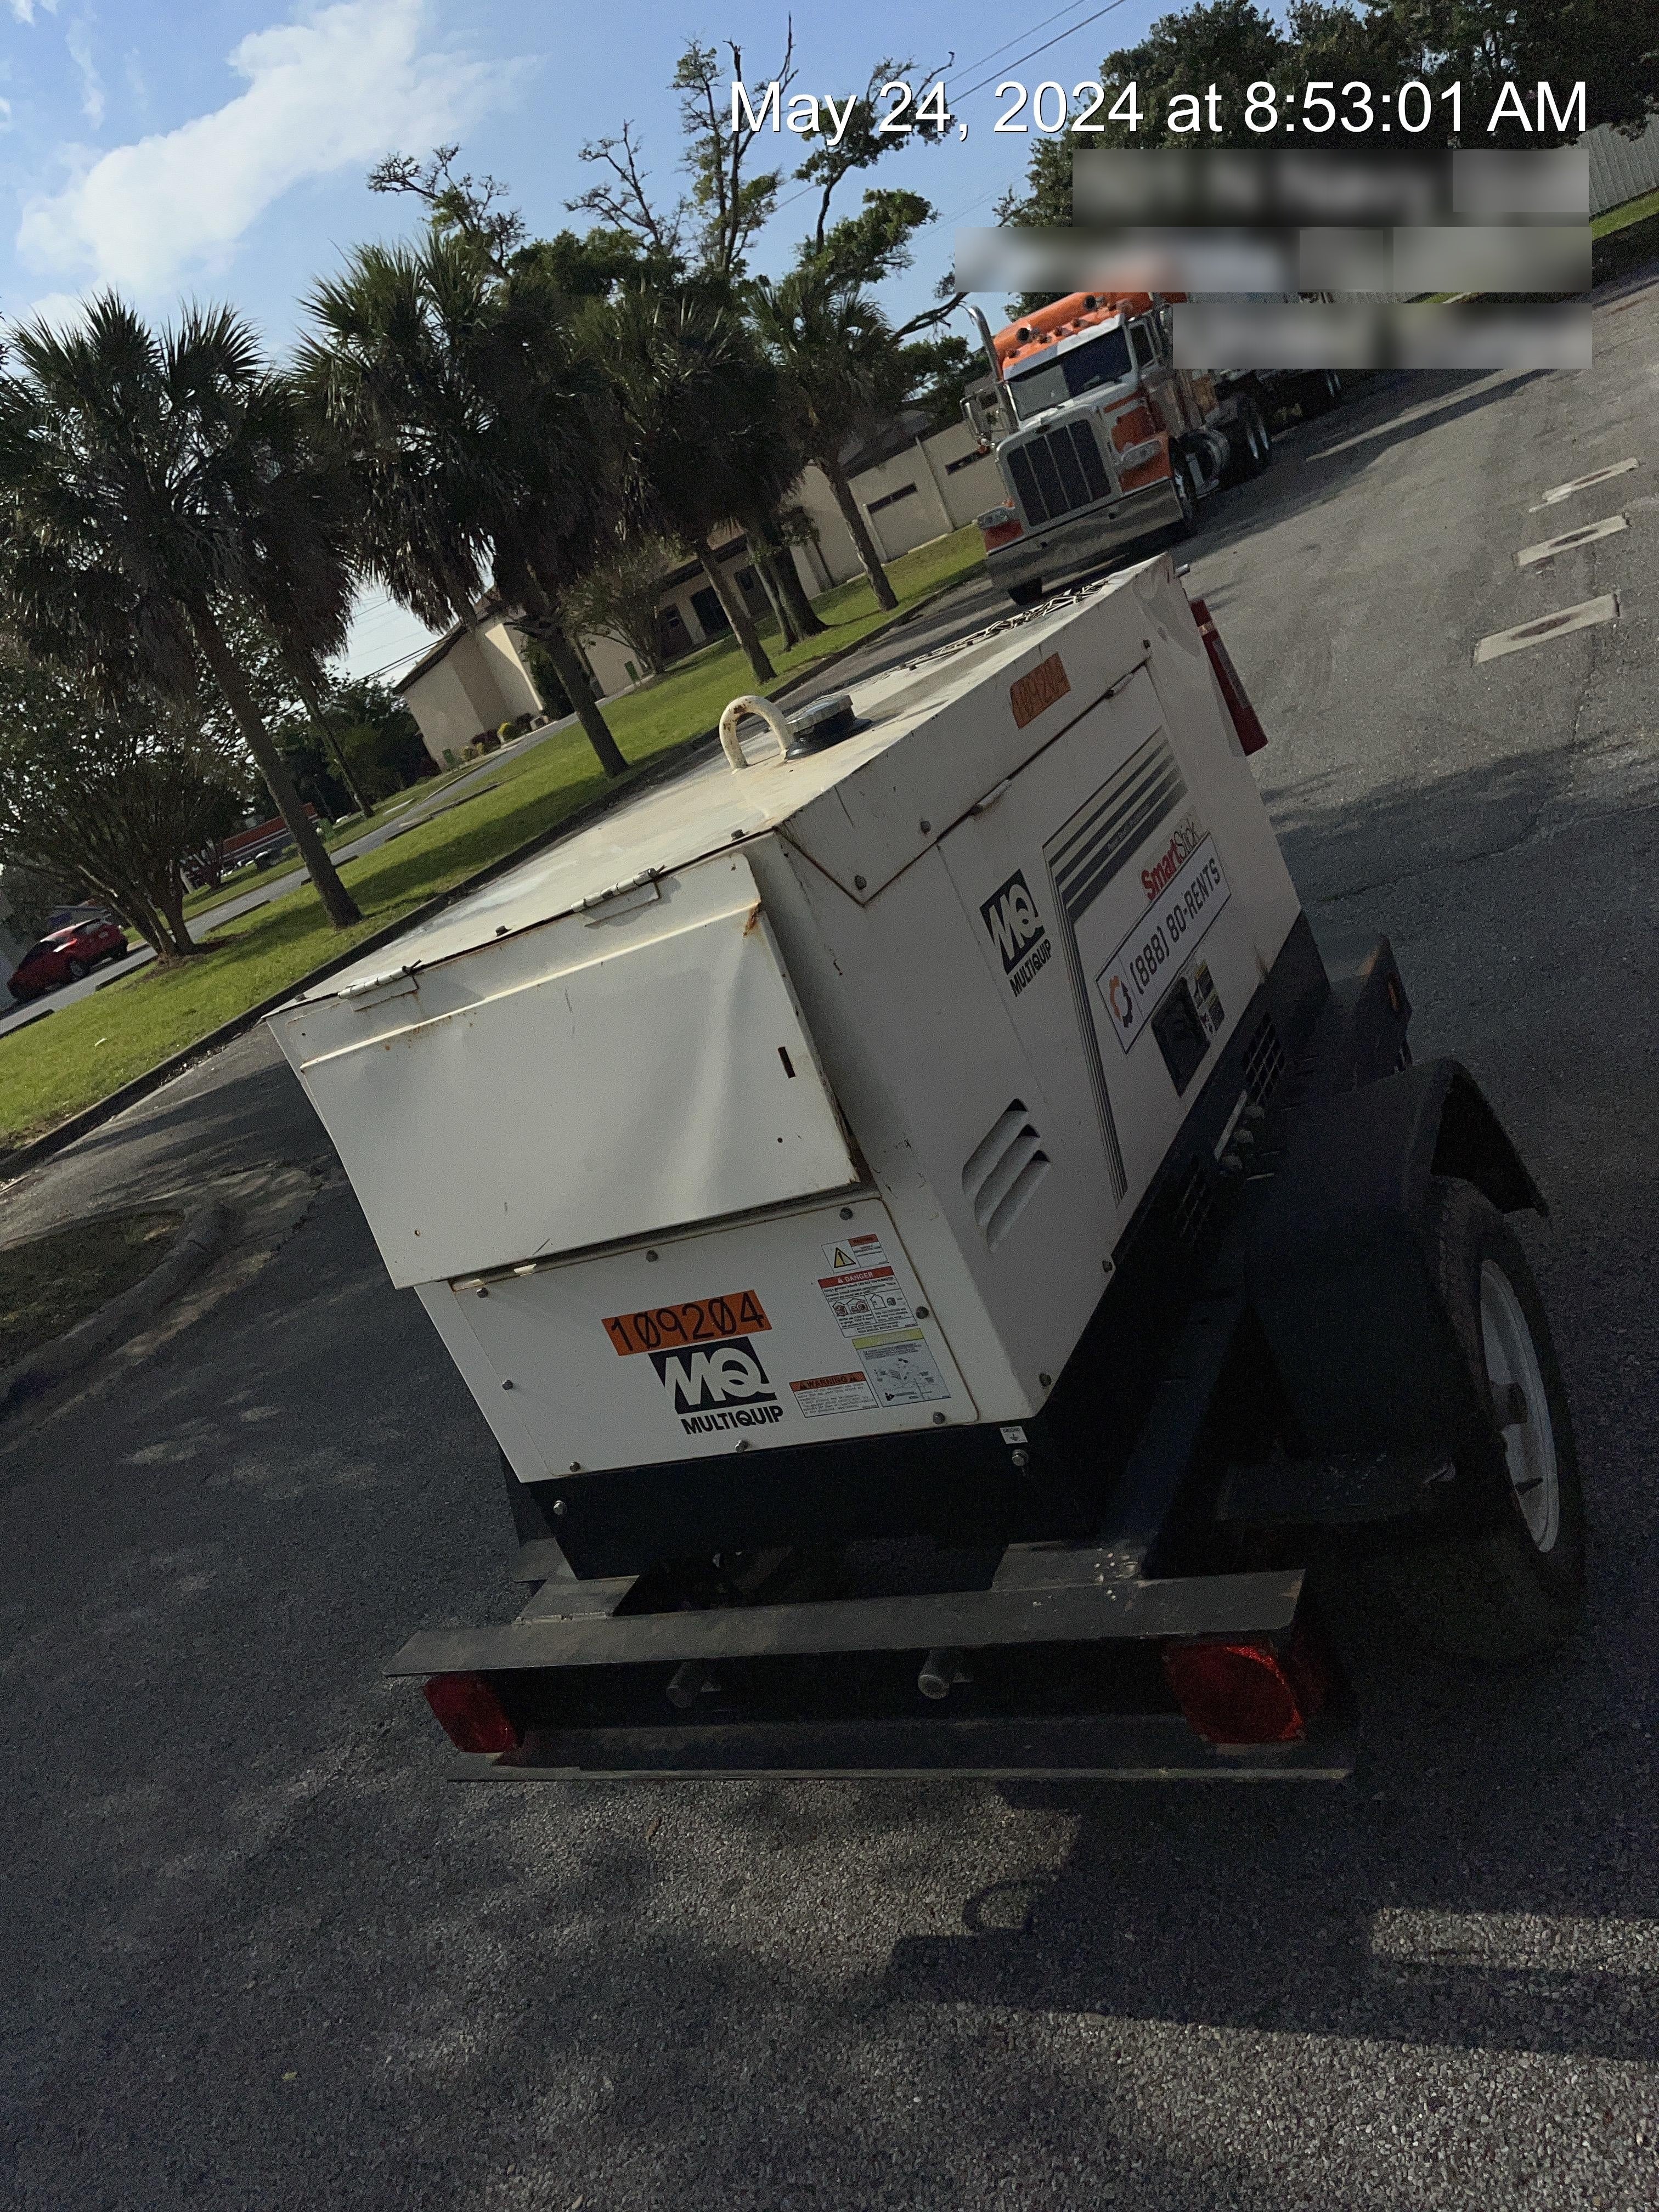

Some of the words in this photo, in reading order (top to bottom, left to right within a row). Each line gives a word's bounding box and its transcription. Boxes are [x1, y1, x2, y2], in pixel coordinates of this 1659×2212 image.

[989, 884, 1043, 961] MQ
[1009, 939, 1052, 997] MULTIQUIP
[1130, 926, 1170, 995] (888)
[844, 1271, 874, 1283] DANGER
[611, 1292, 765, 1352] 109204
[662, 1347, 777, 1406] MQ
[806, 1376, 848, 1388] WARNING
[681, 1406, 784, 1435] MULTIQUIP
